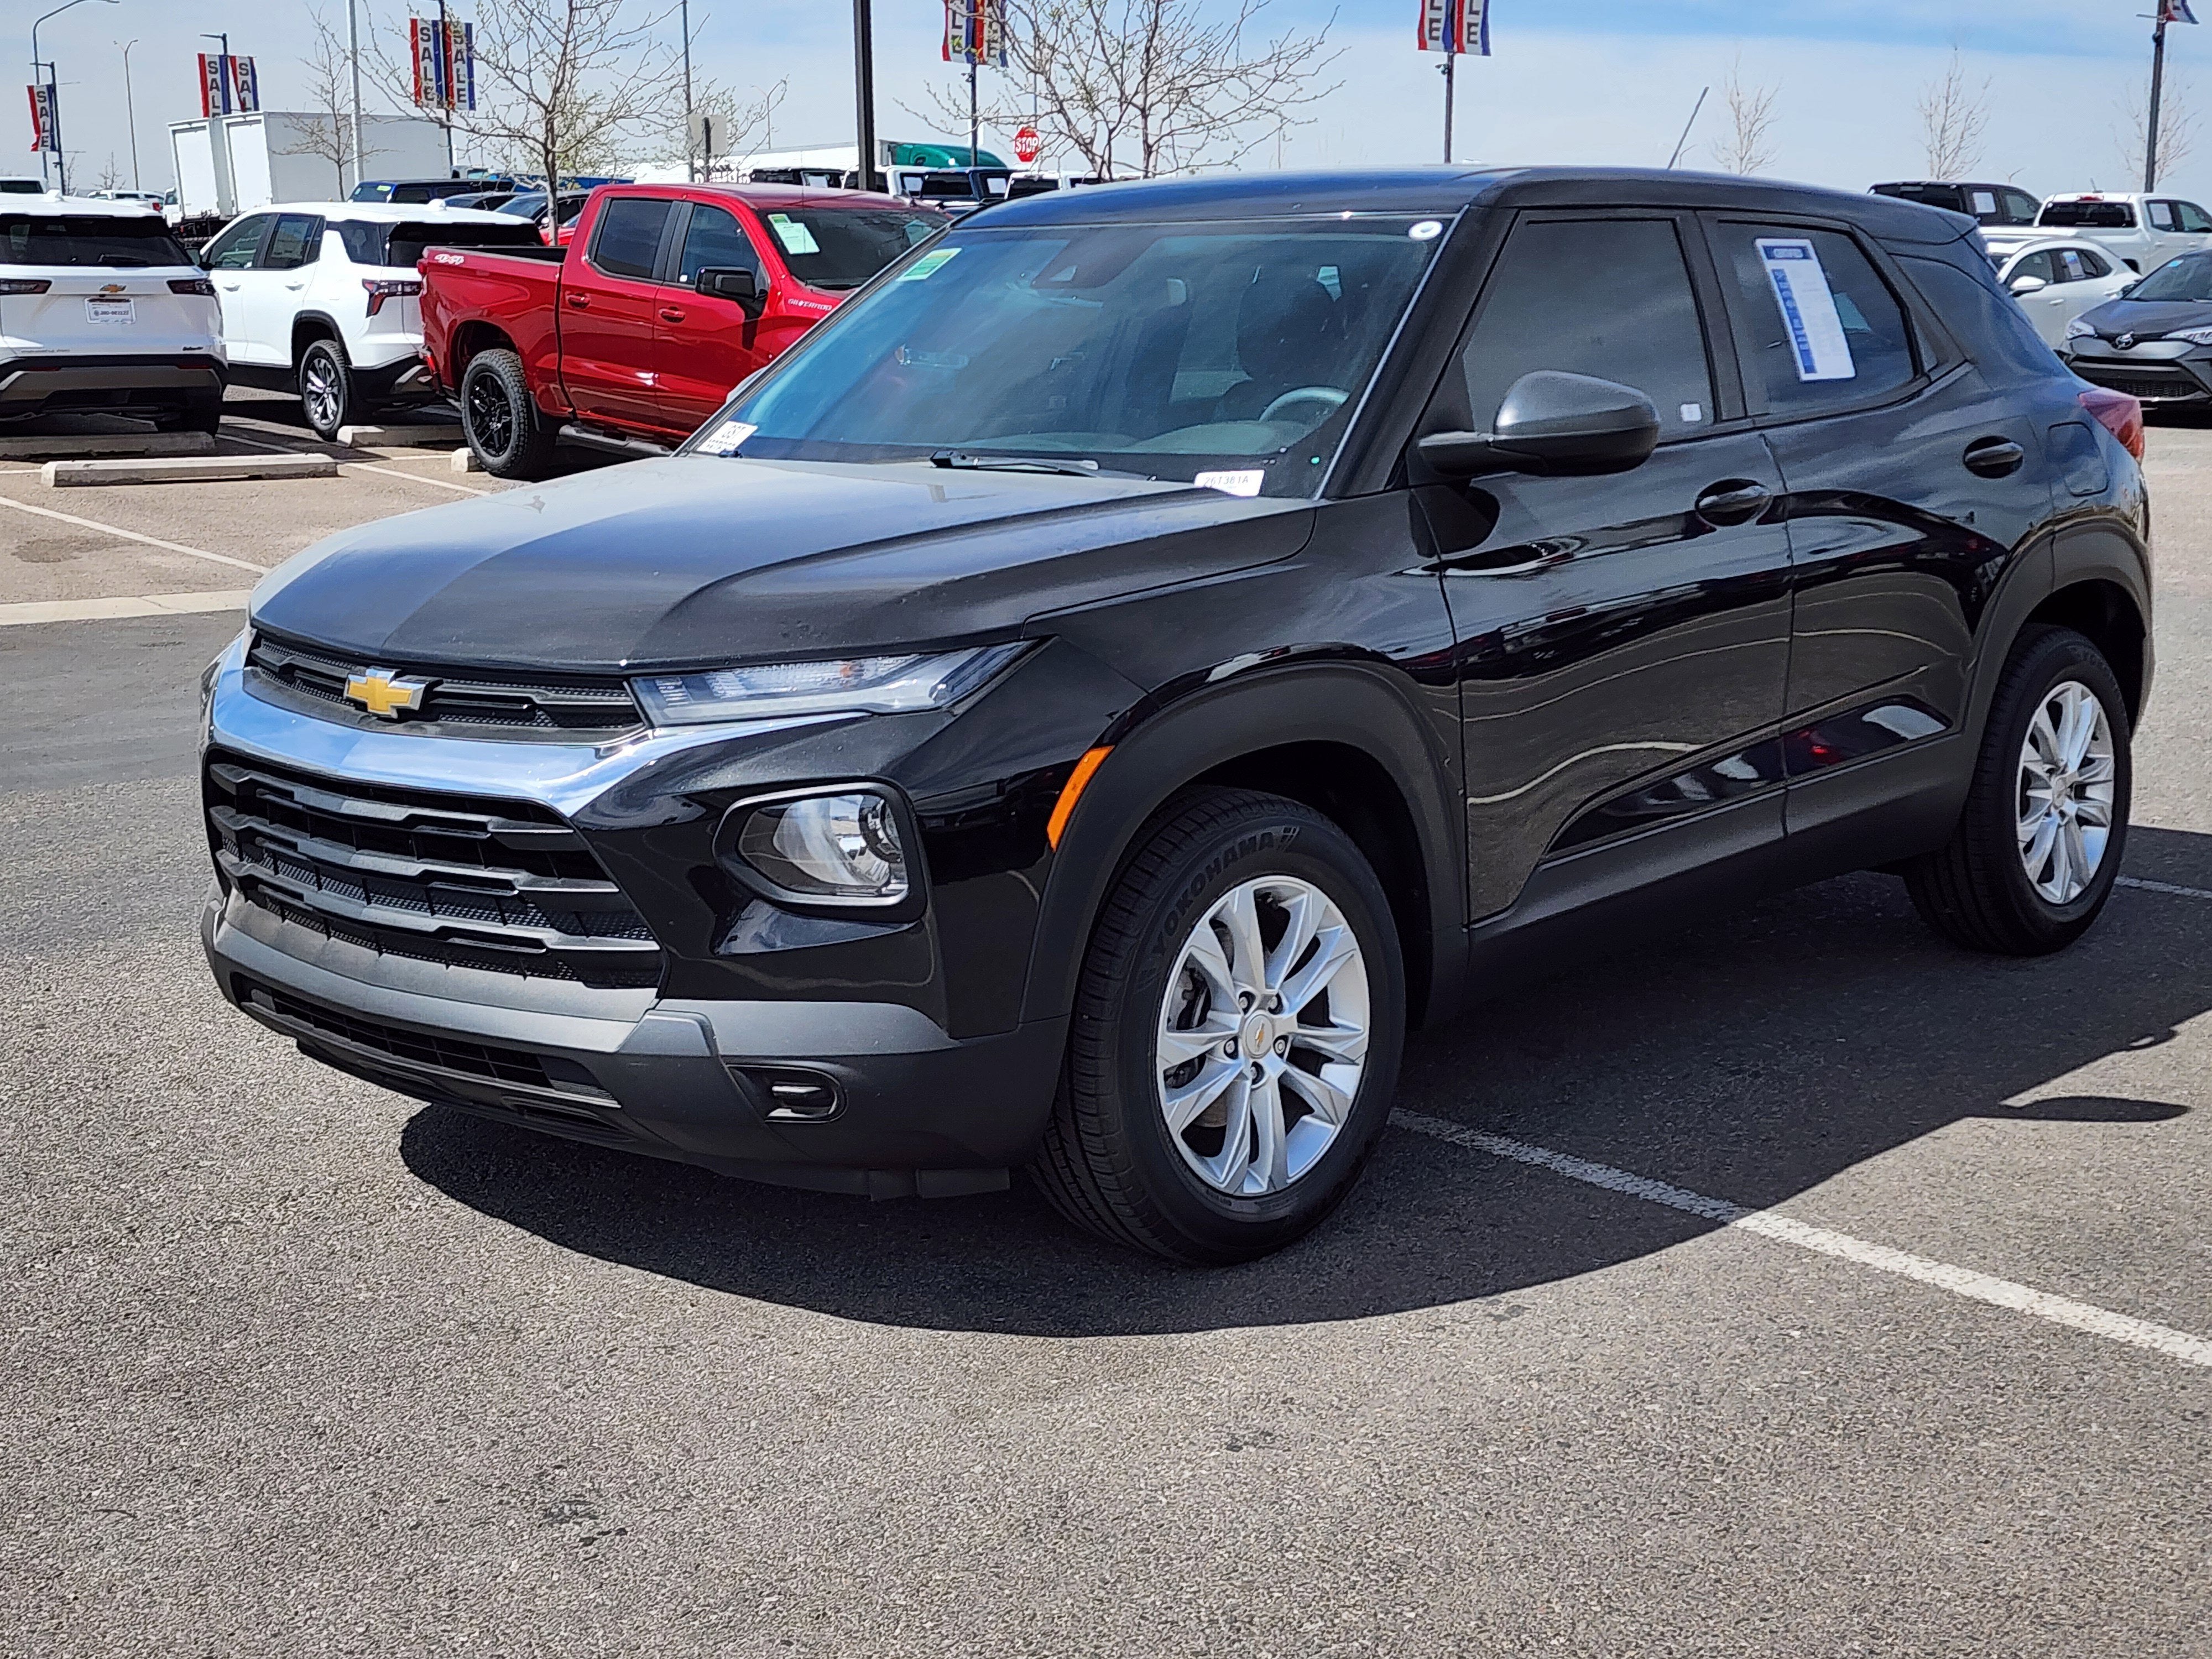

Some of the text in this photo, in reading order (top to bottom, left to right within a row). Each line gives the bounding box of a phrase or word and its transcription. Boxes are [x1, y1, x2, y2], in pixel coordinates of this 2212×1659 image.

[950, 0, 964, 54] LE
[238, 62, 252, 111] SAL
[420, 27, 434, 101] SALE
[453, 29, 467, 103] SALE
[36, 91, 49, 147] SALE
[1015, 137, 1039, 153] STOP
[1151, 831, 1275, 956] YOKOHAMA
